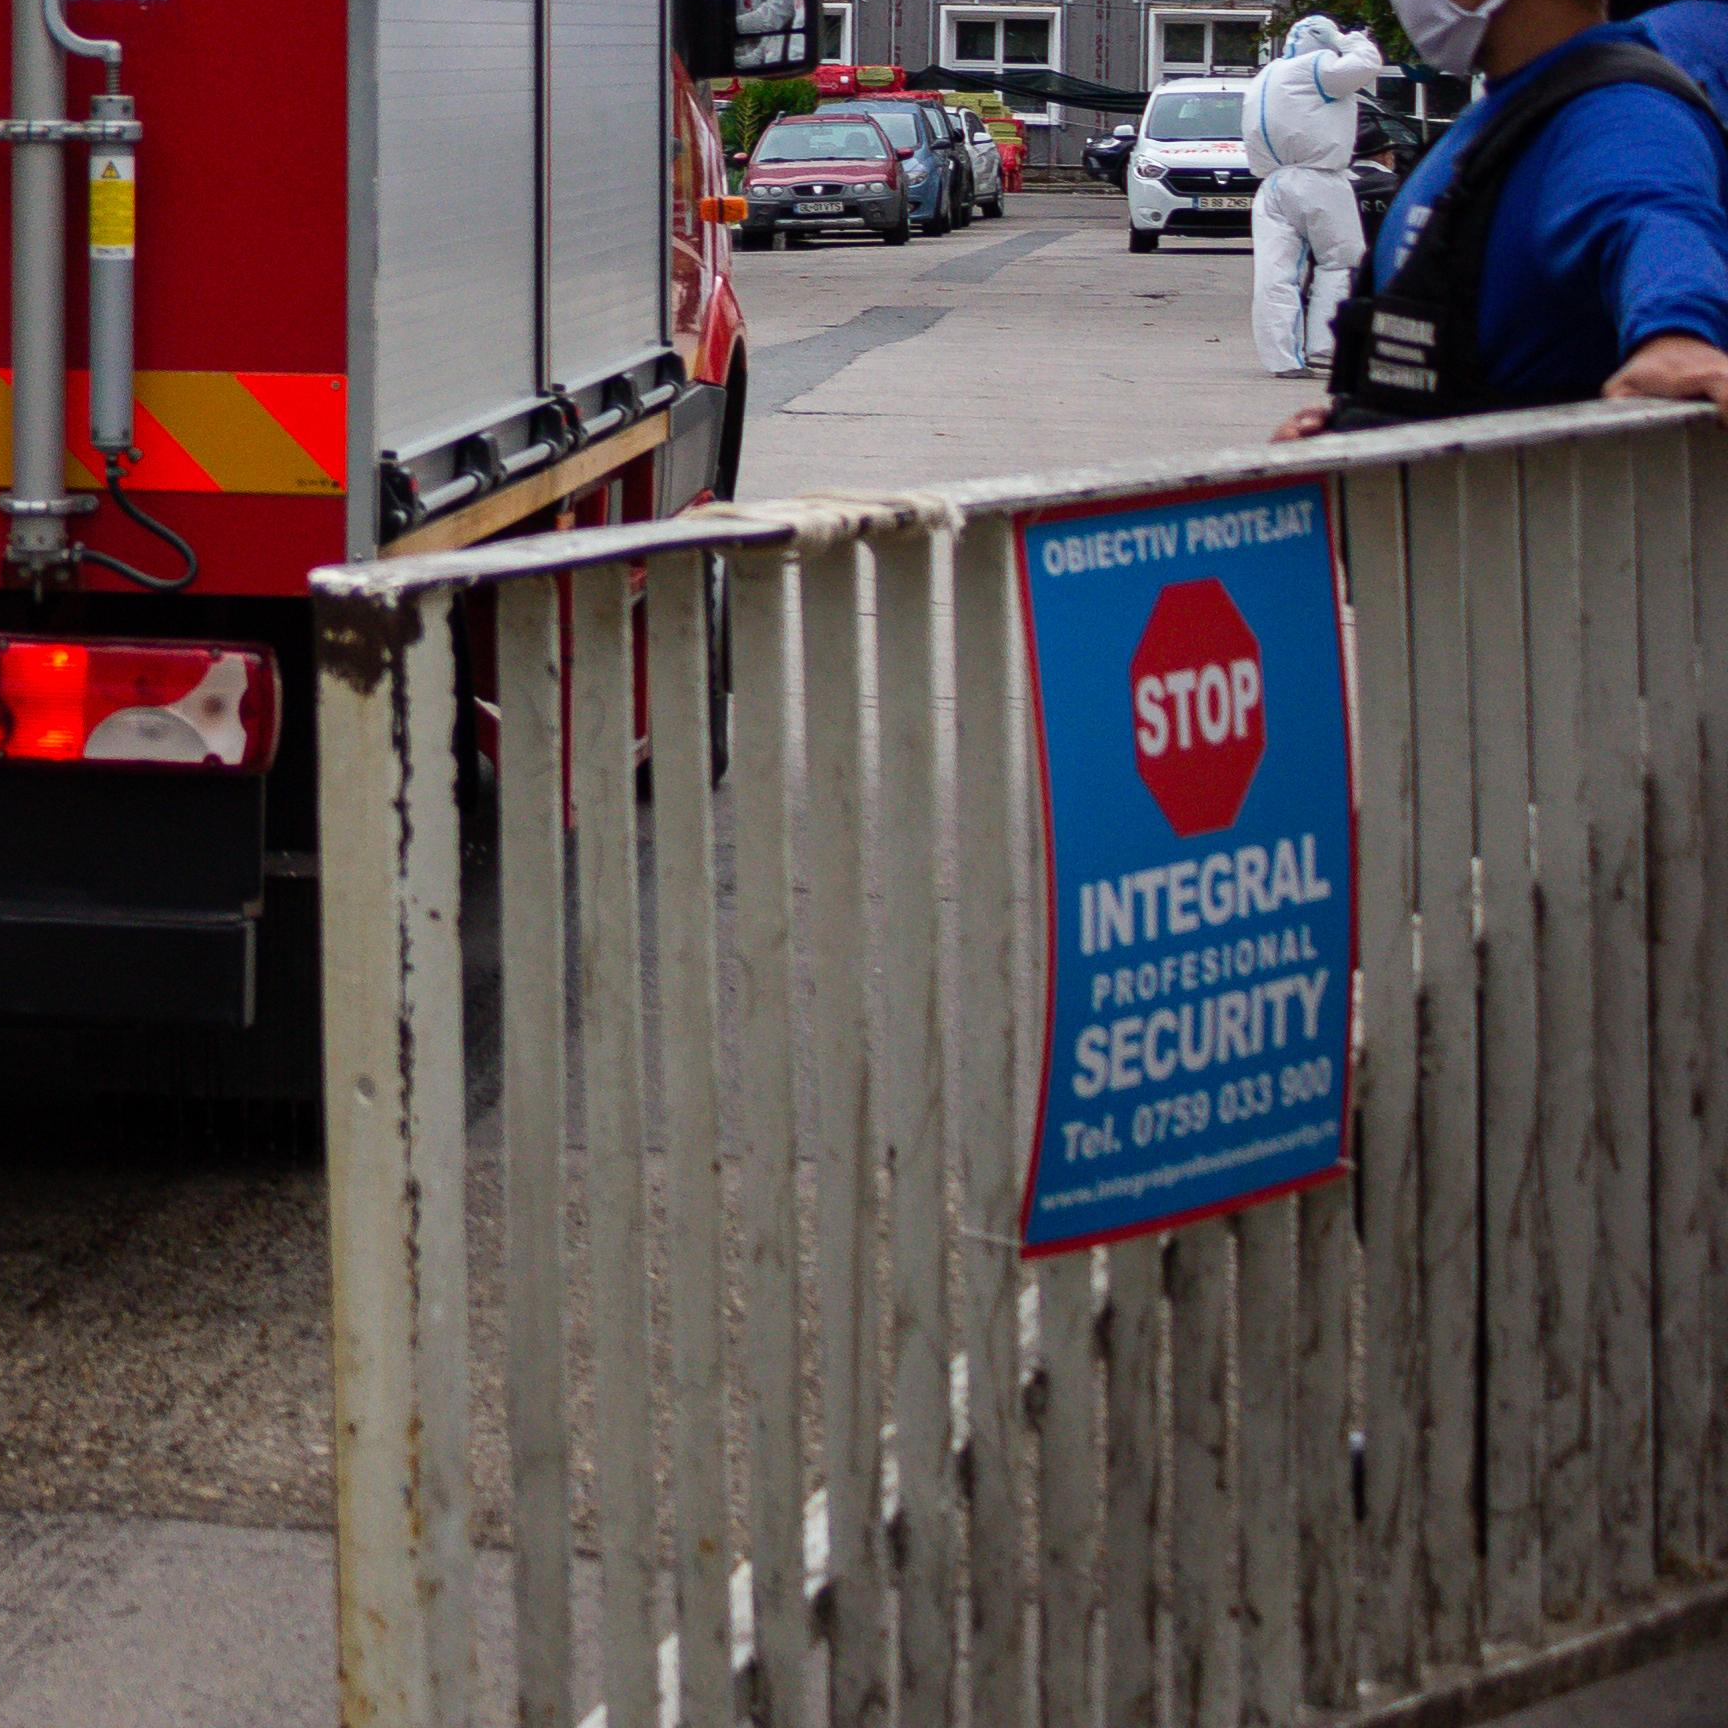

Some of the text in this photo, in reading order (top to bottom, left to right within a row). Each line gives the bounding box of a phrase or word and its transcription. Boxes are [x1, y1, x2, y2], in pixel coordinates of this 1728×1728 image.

[1043, 500, 1313, 576] OBIECTIV PROTEJAT
[1136, 658, 1260, 757] STOP
[1080, 833, 1332, 957] INTEGRAL
[1092, 925, 1319, 1013] PROFESIONAL
[1072, 967, 1331, 1099] SECURITY
[1063, 1114, 1122, 1162] Tel.
[1132, 1091, 1211, 1148] 0759
